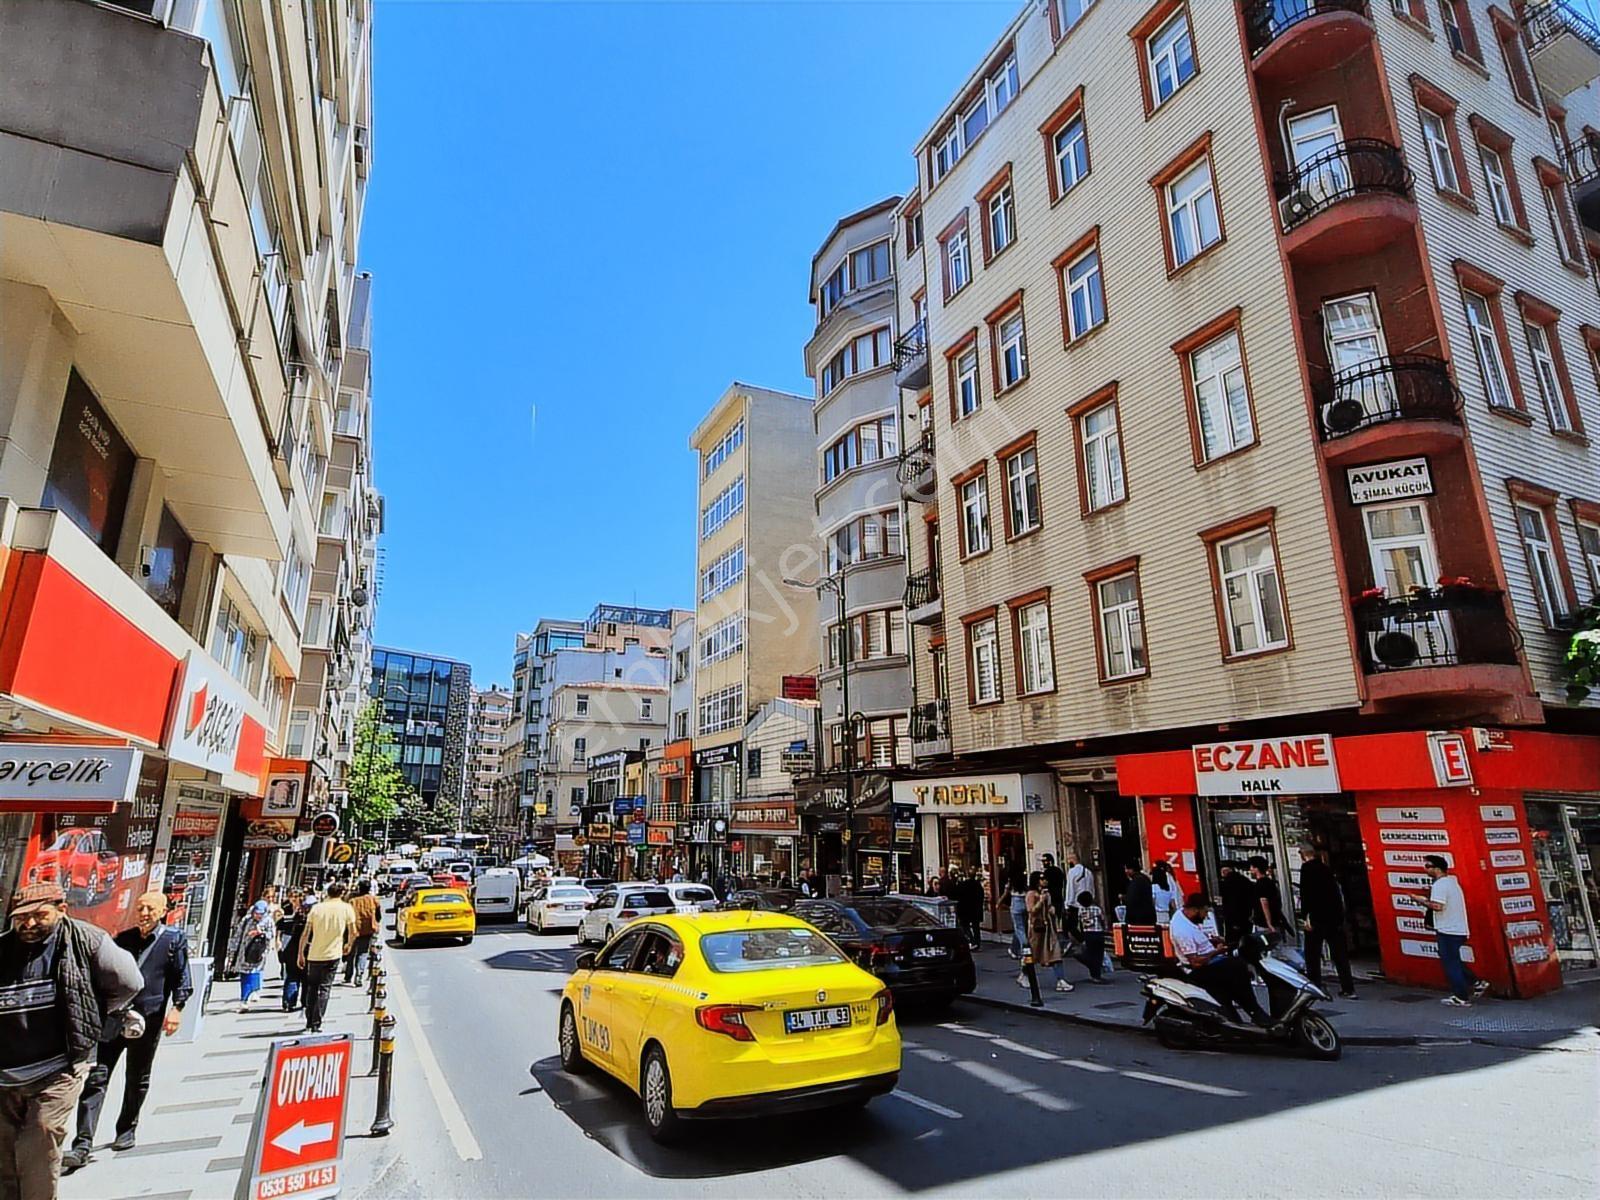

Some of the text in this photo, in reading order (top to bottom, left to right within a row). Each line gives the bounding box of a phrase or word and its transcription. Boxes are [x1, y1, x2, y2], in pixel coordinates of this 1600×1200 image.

[1352, 464, 1425, 485] AVUKAT
[1363, 486, 1393, 501] ŞİMAL
[1395, 481, 1430, 496] KÜÇÜK
[1195, 738, 1329, 772] ECZANE
[1443, 743, 1465, 776] E
[0, 758, 110, 787] arçelik
[1241, 779, 1281, 792] HALK
[791, 1012, 805, 1027] 34
[811, 1010, 830, 1025] TJK
[836, 1008, 849, 1022] 93
[277, 1052, 344, 1107] OTOPARK
[261, 1167, 334, 1198] 0533 550 14 53
